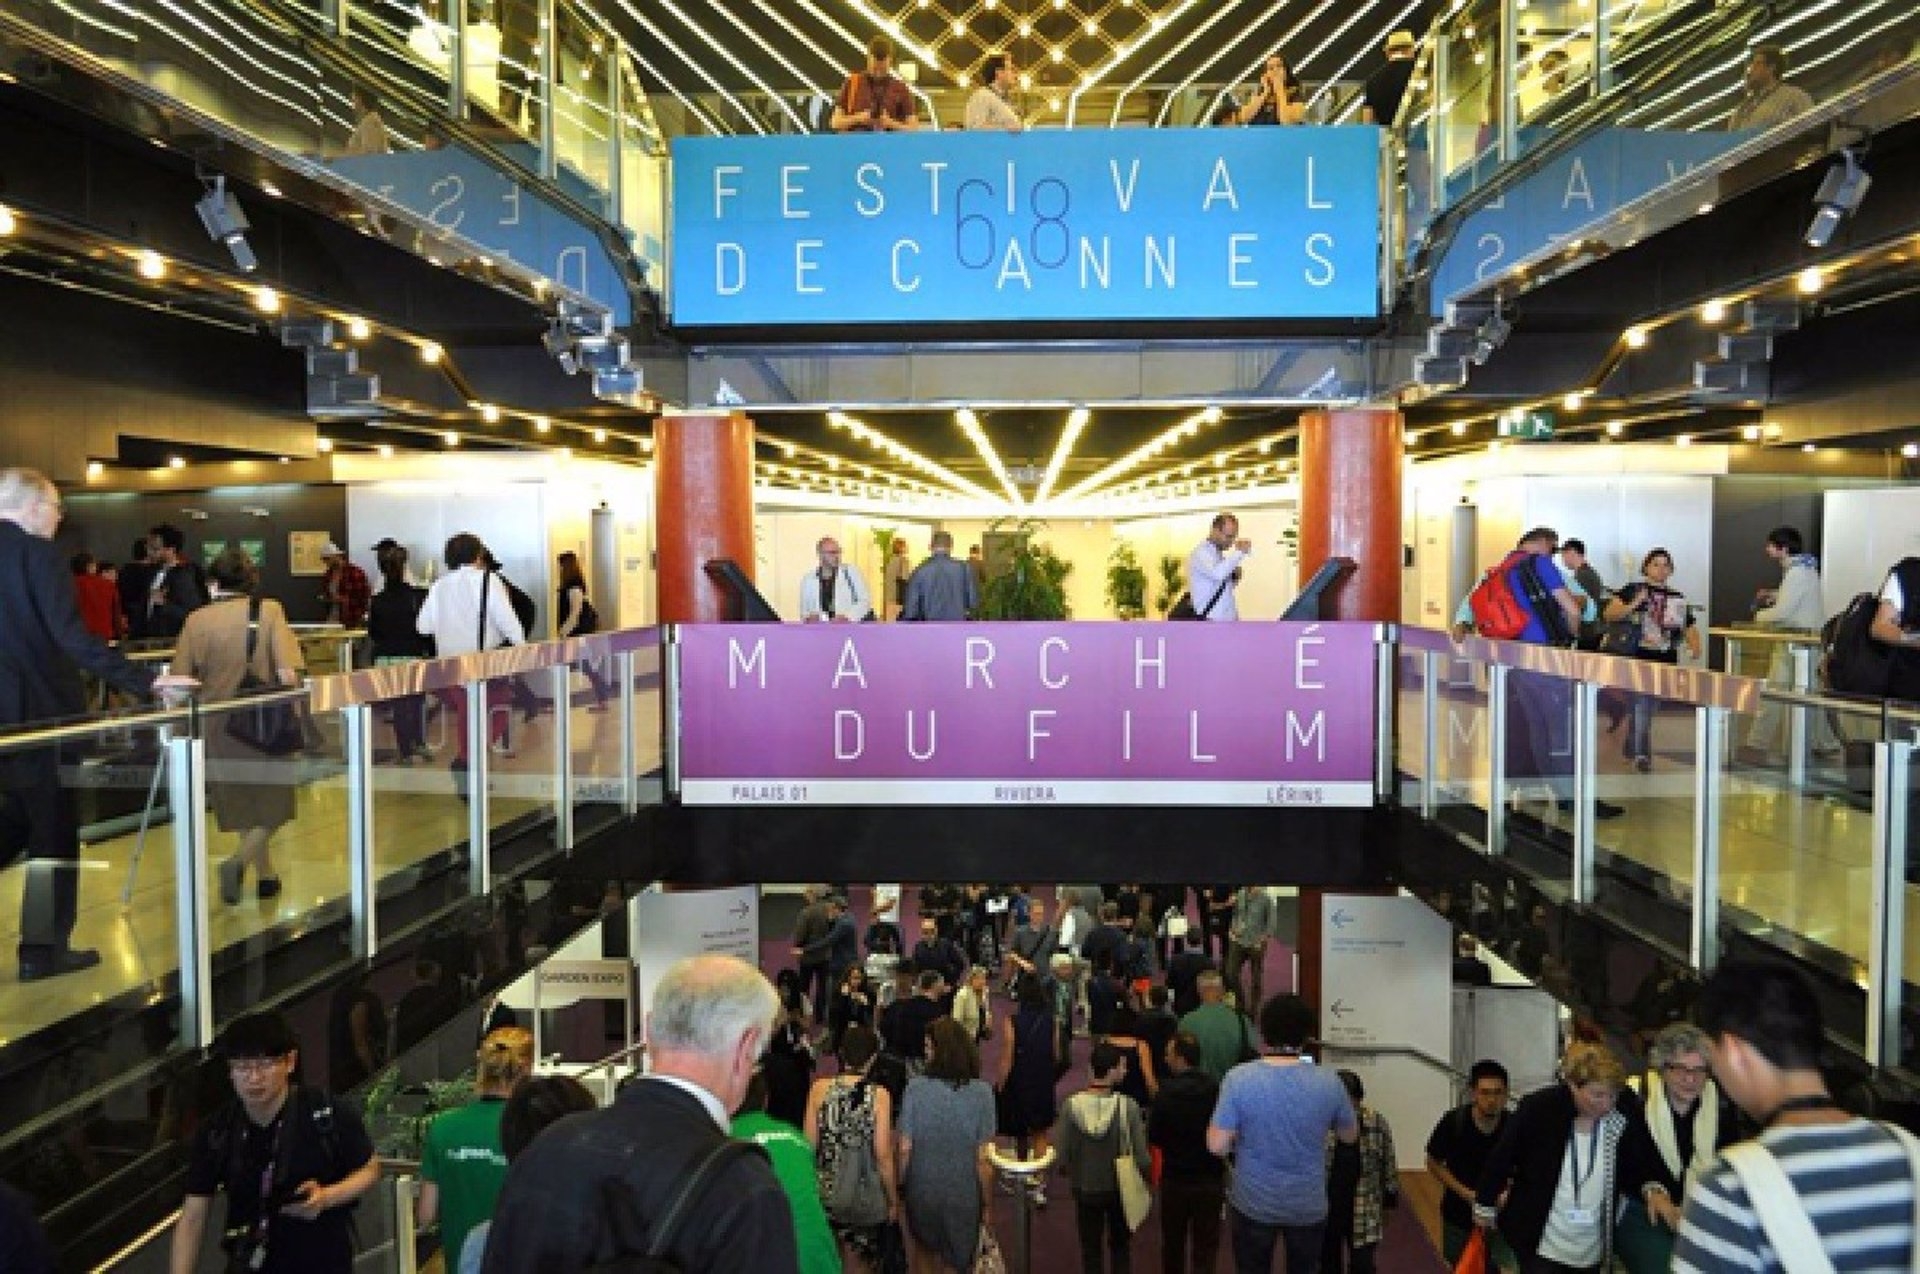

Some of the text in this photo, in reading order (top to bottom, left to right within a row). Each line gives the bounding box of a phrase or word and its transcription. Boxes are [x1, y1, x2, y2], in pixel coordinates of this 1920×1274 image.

[713, 156, 1335, 219] FESTIVAL
[955, 177, 1071, 270] 68
[715, 233, 1336, 296] DE CANNES
[728, 624, 1326, 690] MARCHÉ
[834, 709, 1327, 763] DU FILM
[732, 784, 785, 801] PALAIS
[993, 785, 1057, 801] RIVIERA
[1266, 783, 1325, 804] LÉRINS
